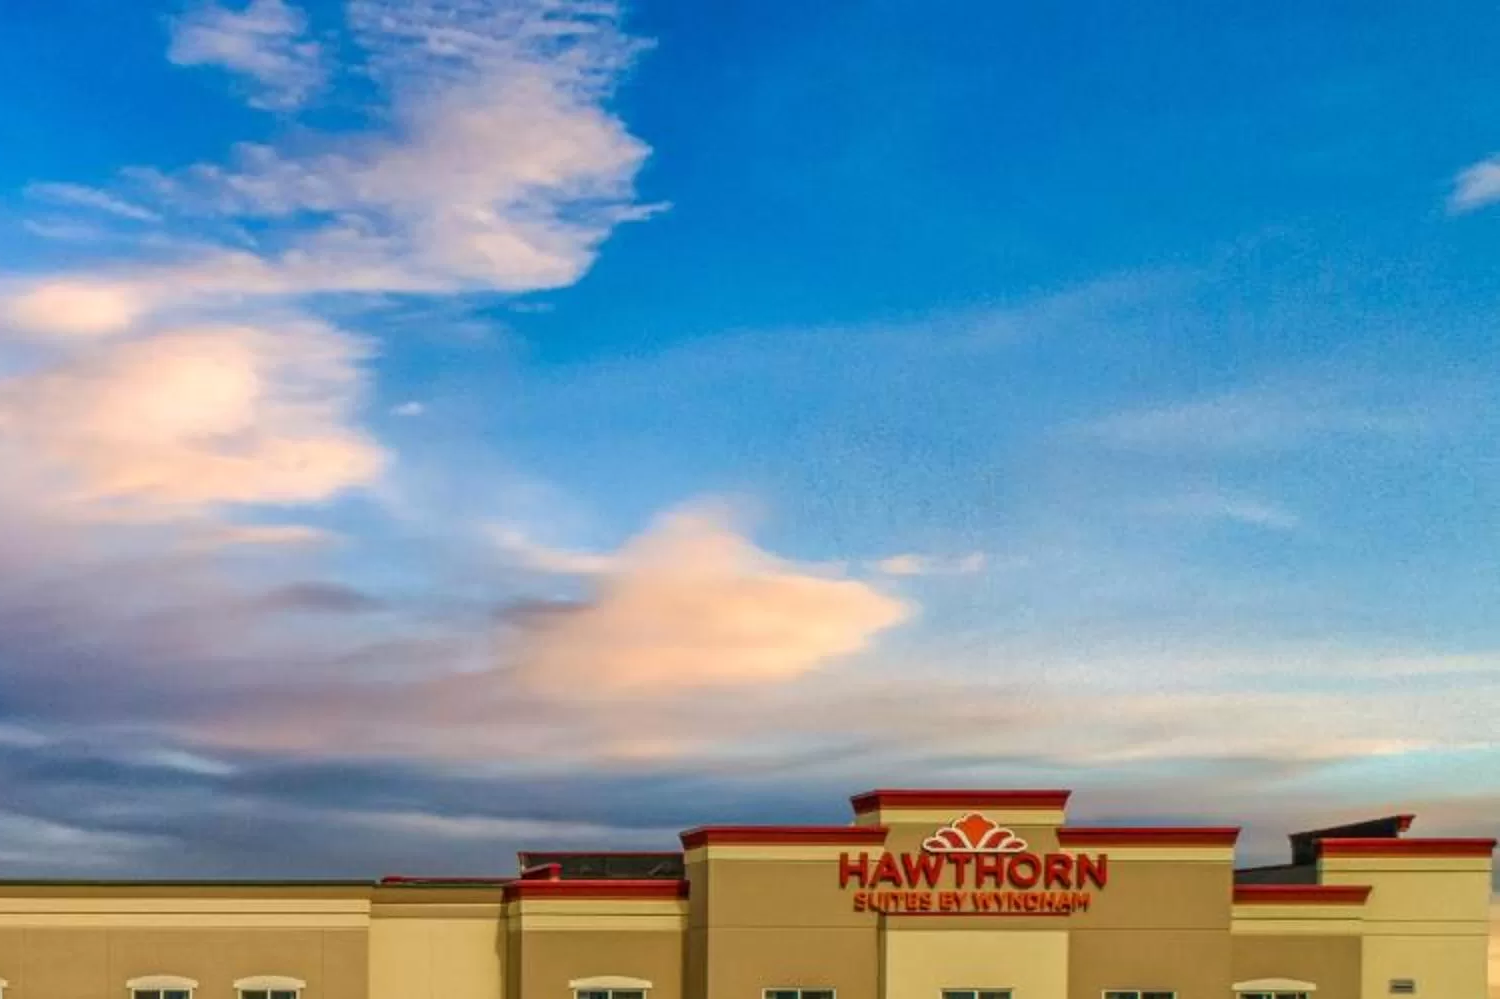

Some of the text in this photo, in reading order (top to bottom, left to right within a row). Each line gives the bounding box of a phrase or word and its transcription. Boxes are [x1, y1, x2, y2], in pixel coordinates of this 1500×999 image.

[839, 852, 1108, 890] HAWTHORN
[853, 891, 1091, 912] SUITES BY WYNDHAM
